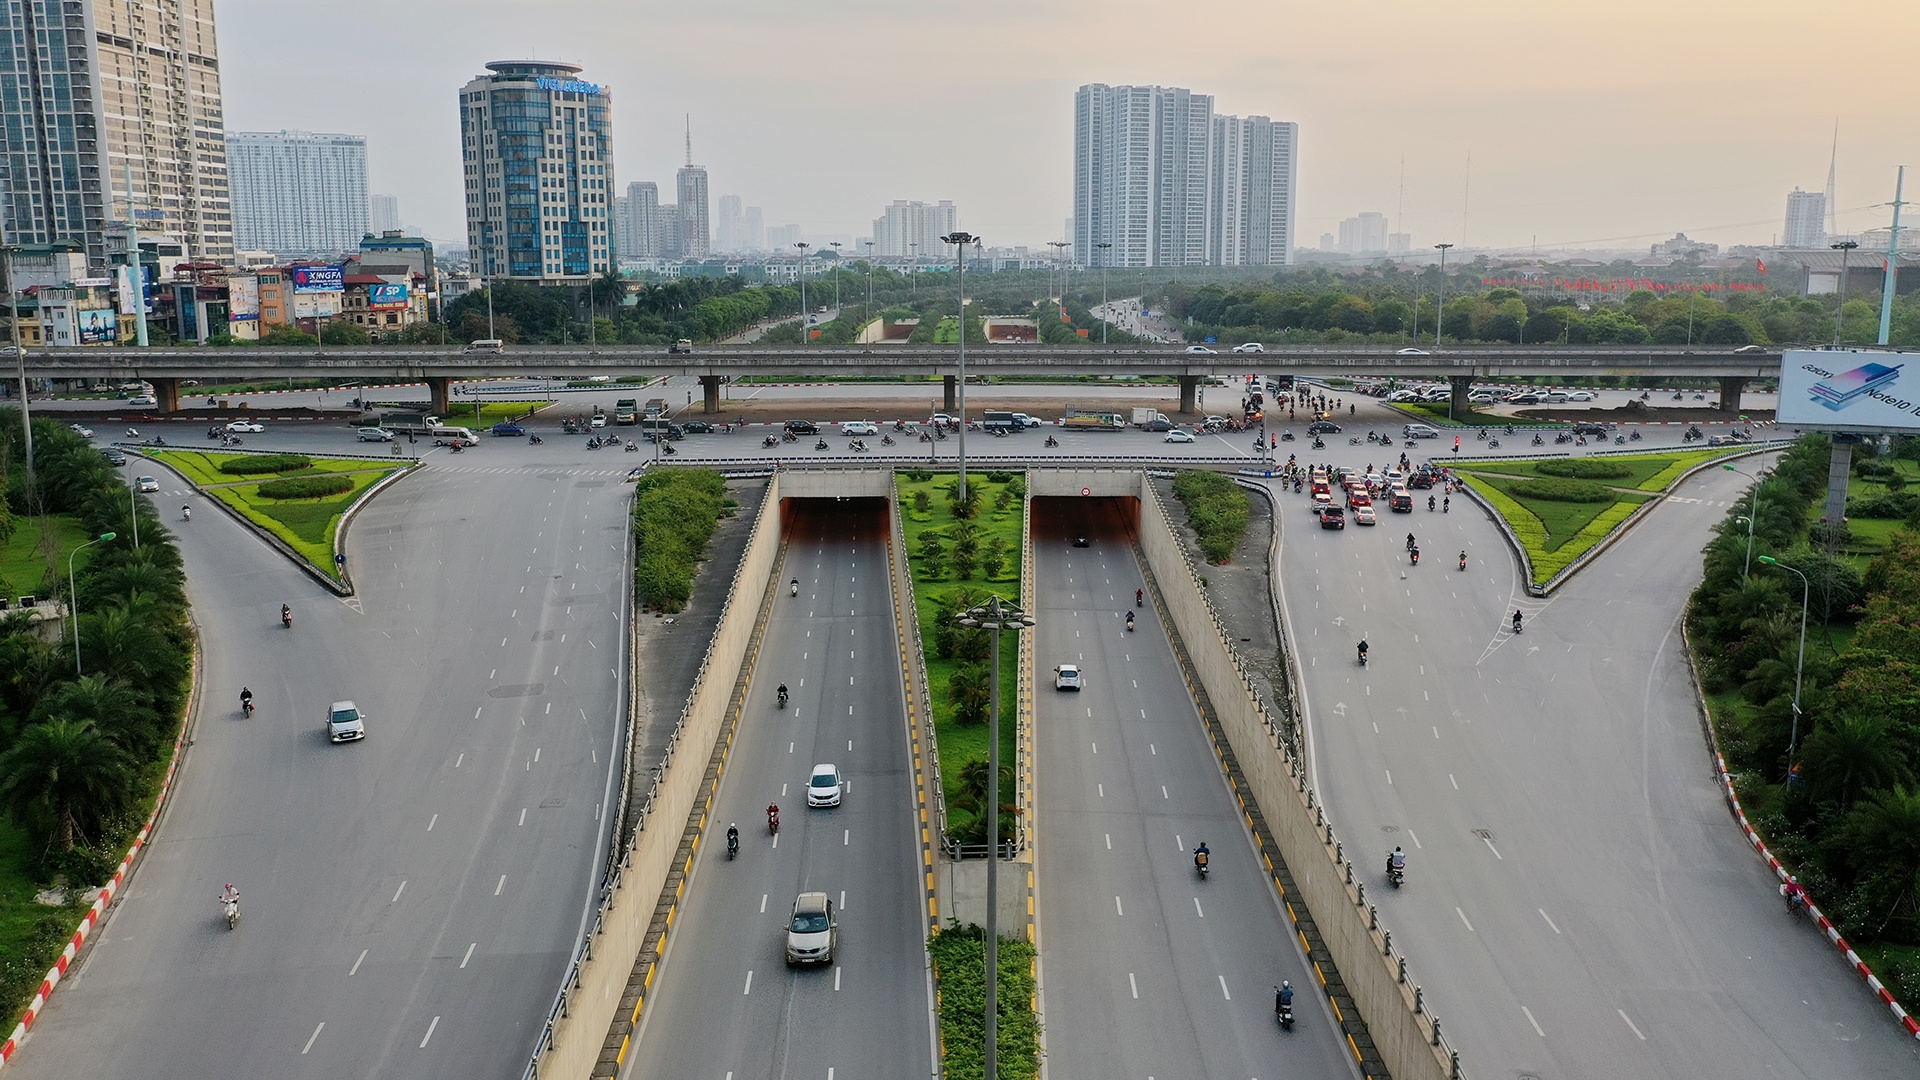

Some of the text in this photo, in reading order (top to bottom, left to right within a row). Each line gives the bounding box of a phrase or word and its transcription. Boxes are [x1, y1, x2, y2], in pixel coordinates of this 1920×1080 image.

[536, 78, 600, 94] VIGLACERA
[386, 286, 400, 296] SP
[1801, 364, 1834, 379] Galaxy
